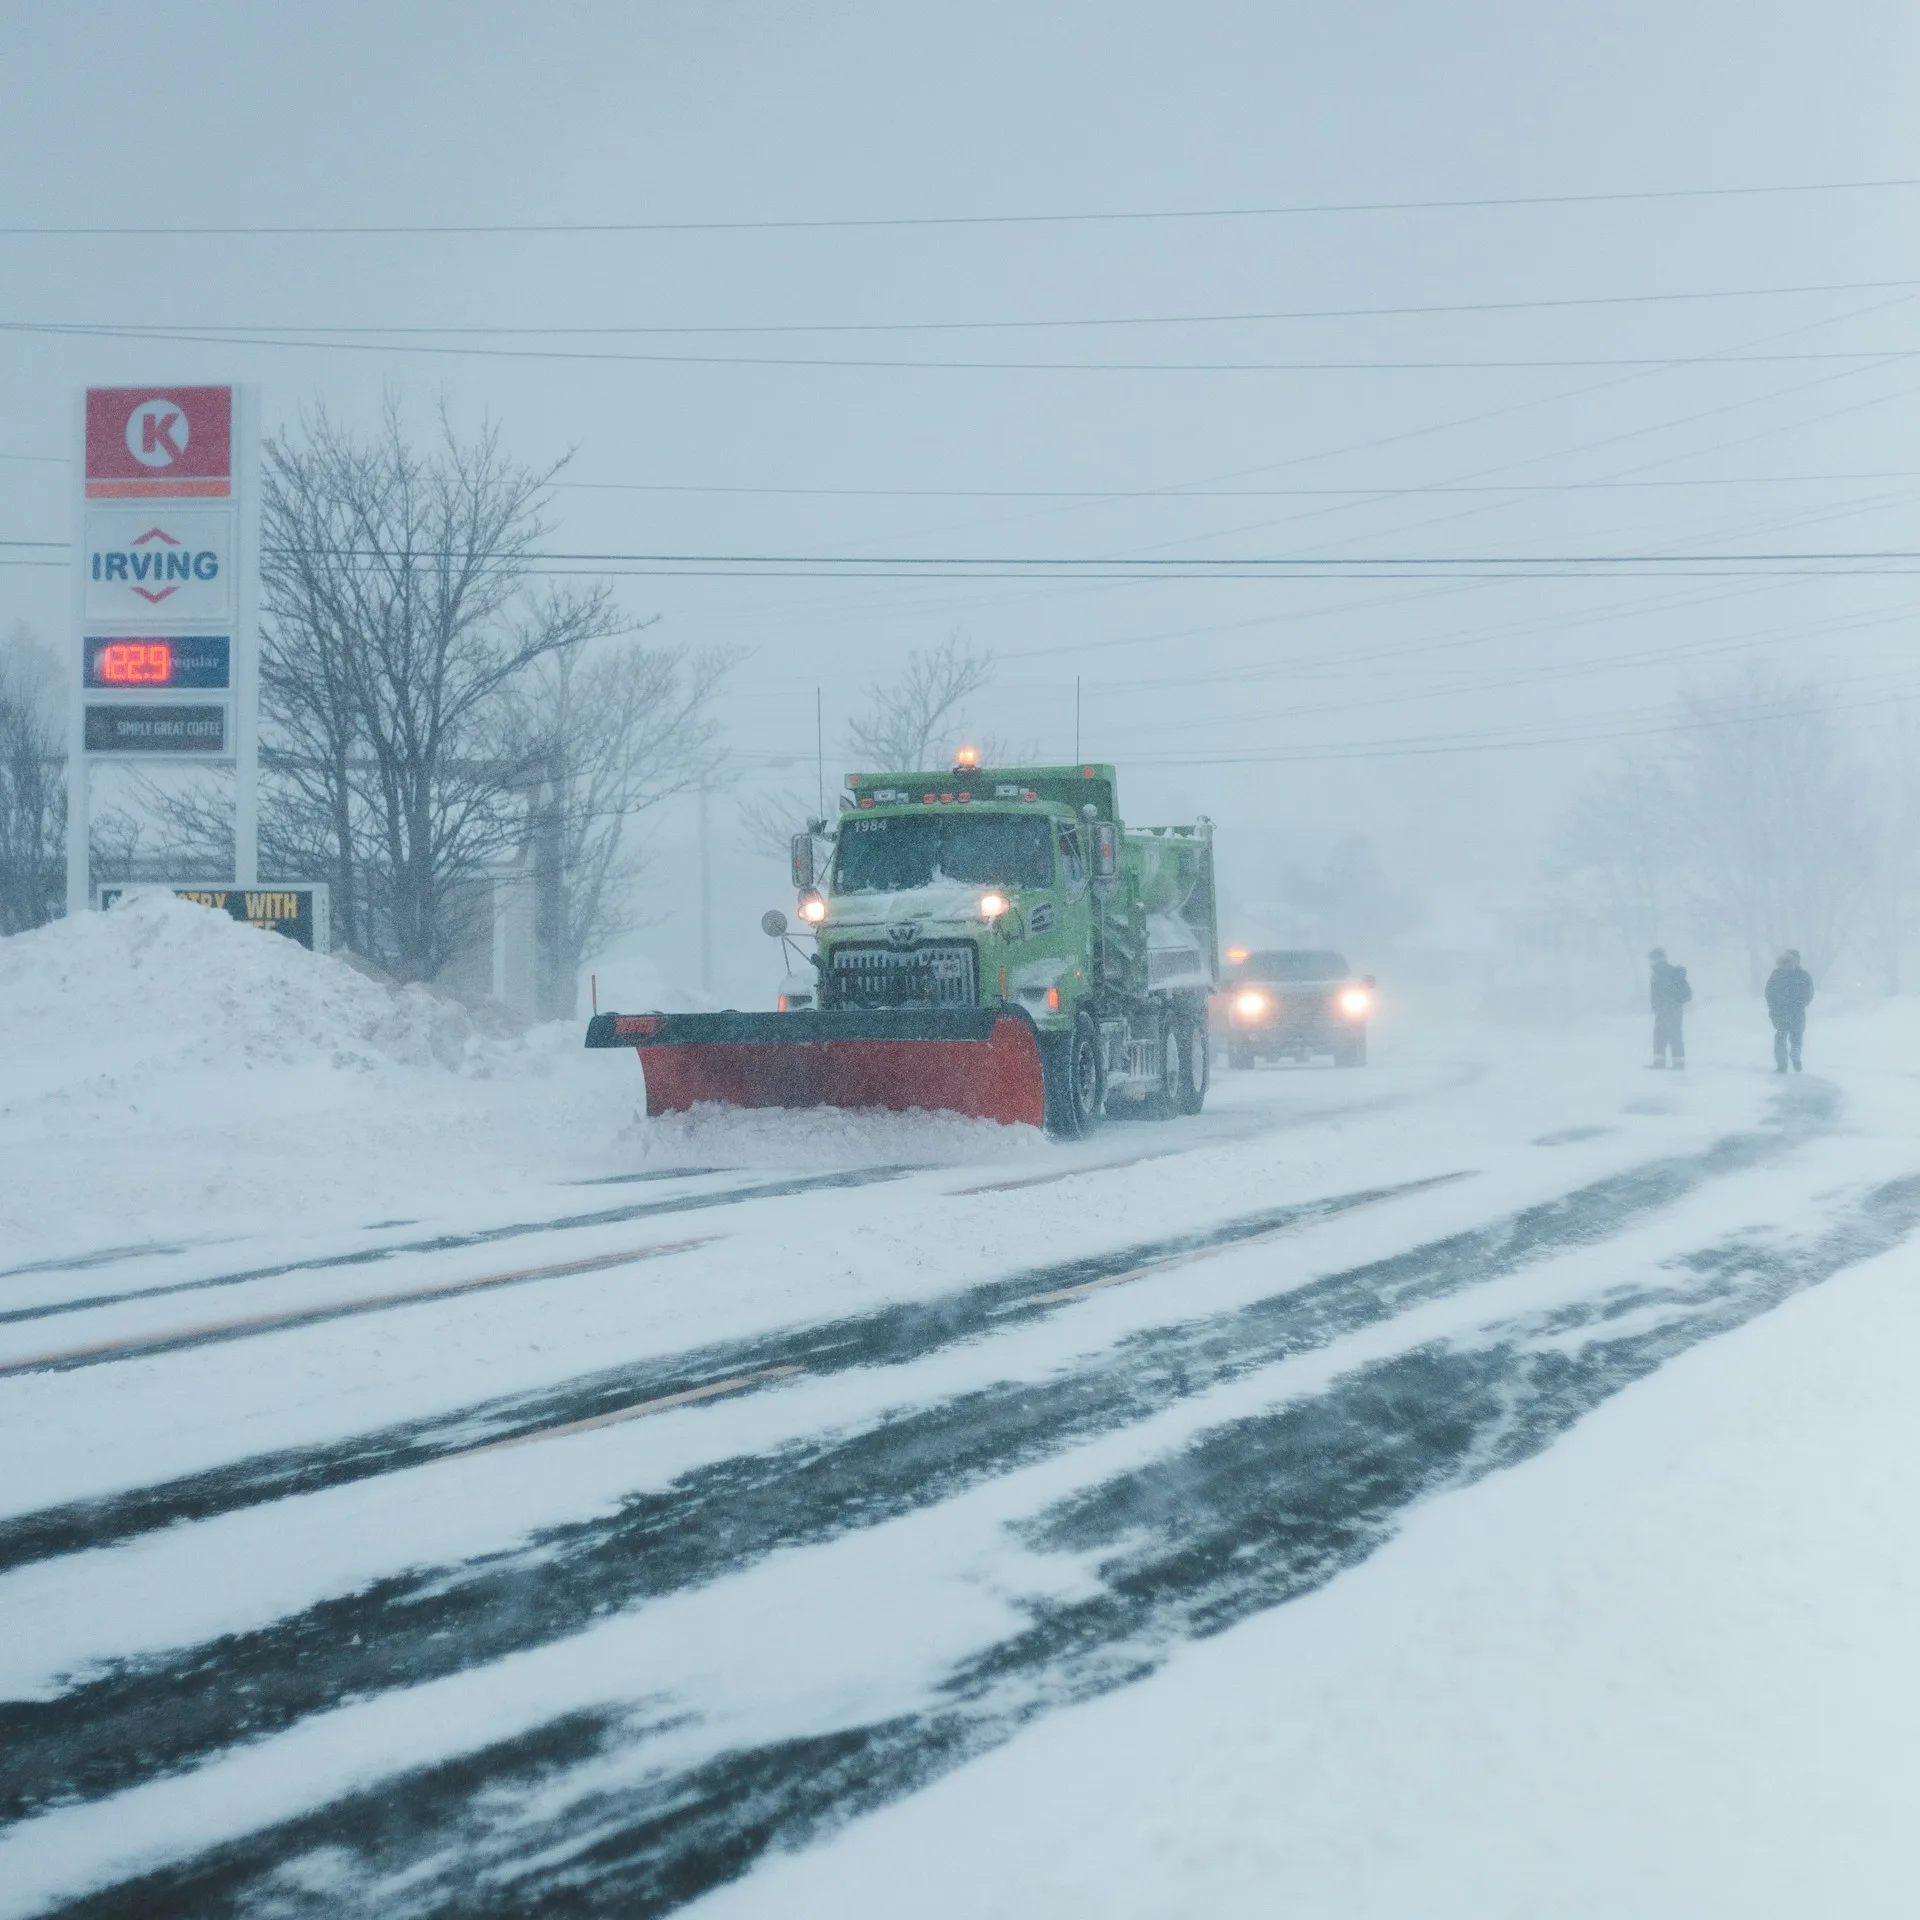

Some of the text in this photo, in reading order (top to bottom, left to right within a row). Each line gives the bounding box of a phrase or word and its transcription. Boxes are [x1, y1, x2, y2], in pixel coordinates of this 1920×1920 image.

[142, 413, 184, 463] K
[92, 552, 218, 580] IRVING
[169, 656, 220, 669] regular
[117, 721, 221, 736] SIMPLY GREAT COFFEE
[854, 820, 888, 832] 1984
[245, 893, 298, 919] WITH
